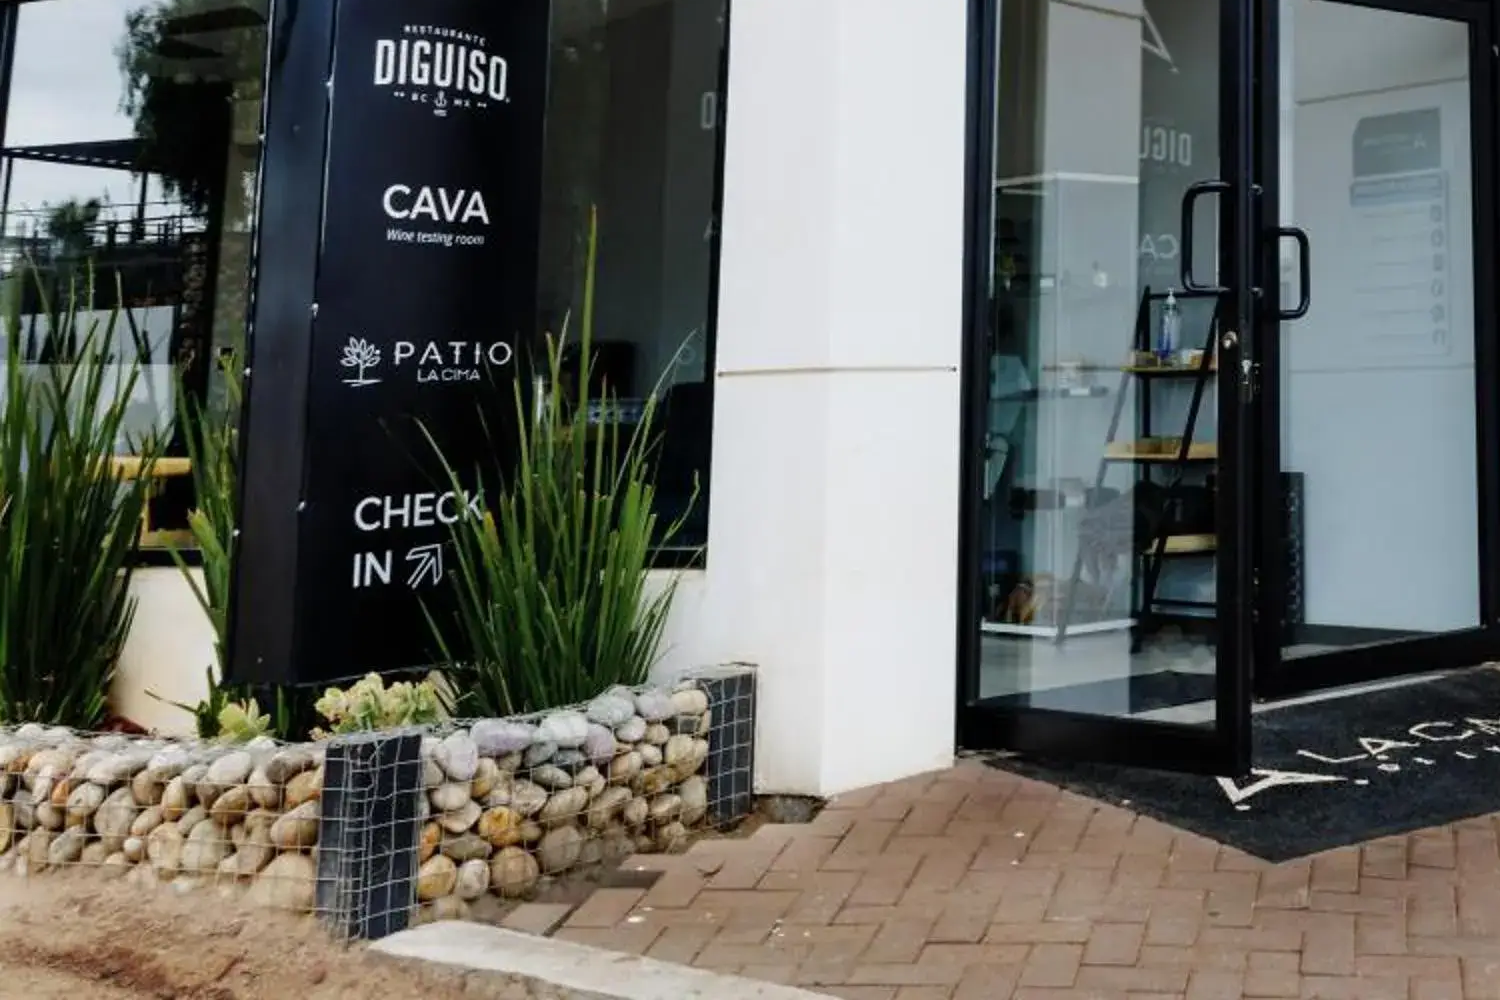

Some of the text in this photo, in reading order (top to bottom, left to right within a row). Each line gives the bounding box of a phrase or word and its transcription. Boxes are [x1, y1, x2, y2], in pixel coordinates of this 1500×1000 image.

[403, 24, 486, 47] RESTAURANTE
[374, 38, 508, 102] DIGUISO
[382, 183, 490, 225] CAVA
[386, 227, 415, 243] Wine
[454, 235, 486, 246] room
[394, 341, 513, 366] PATIO
[353, 489, 485, 531] CHECK
[352, 549, 393, 589] IN
